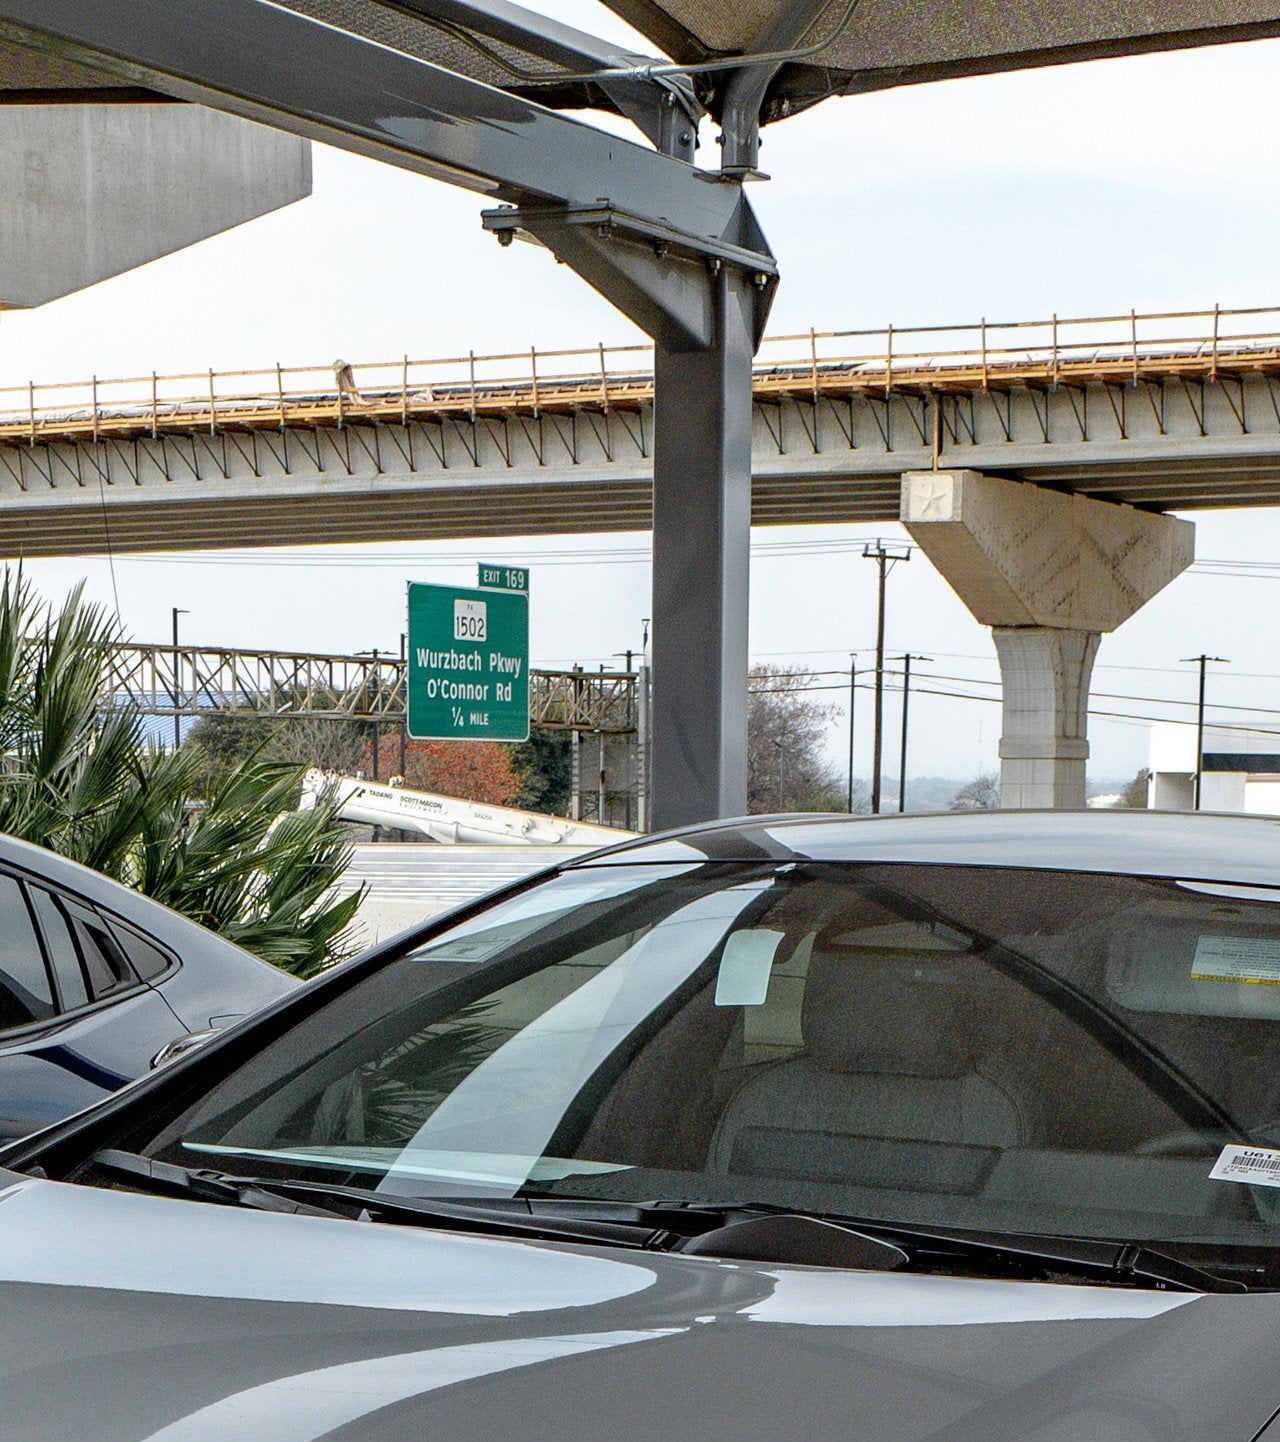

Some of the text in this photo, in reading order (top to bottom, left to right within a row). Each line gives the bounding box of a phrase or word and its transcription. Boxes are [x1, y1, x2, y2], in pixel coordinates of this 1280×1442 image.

[483, 569, 525, 588] EXIT 169
[456, 616, 485, 638] 1502
[416, 648, 521, 678] Wurzbach Pkwy
[427, 679, 512, 701] O'Connor Rd
[470, 713, 489, 726] MILE
[369, 789, 393, 800] TADANO
